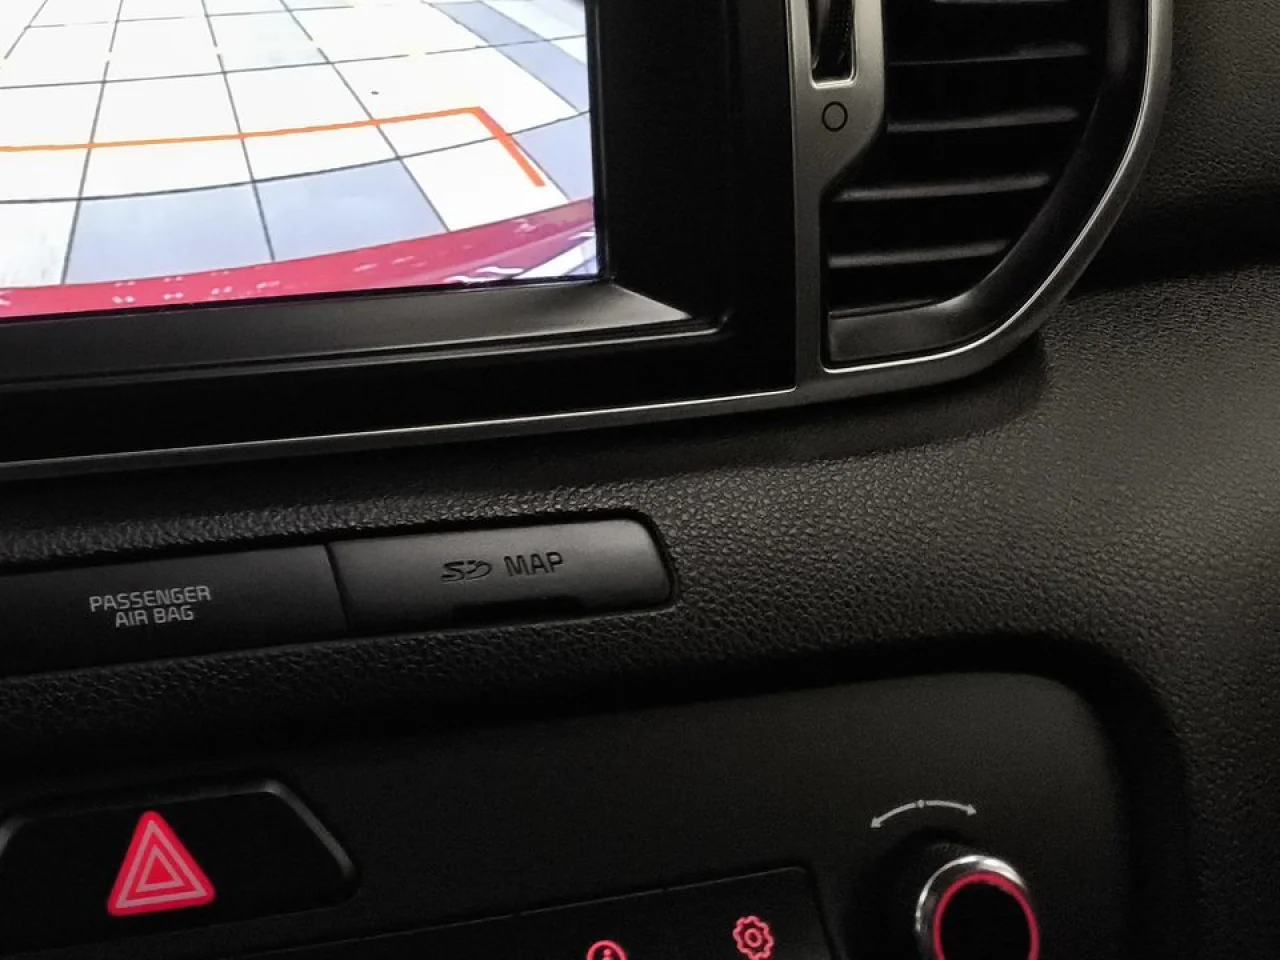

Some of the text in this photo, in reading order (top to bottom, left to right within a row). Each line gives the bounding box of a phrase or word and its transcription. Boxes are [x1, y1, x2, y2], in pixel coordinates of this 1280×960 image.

[503, 551, 564, 578] MAP
[88, 585, 212, 613] PASSENGER
[115, 604, 195, 629] AIR BAG
